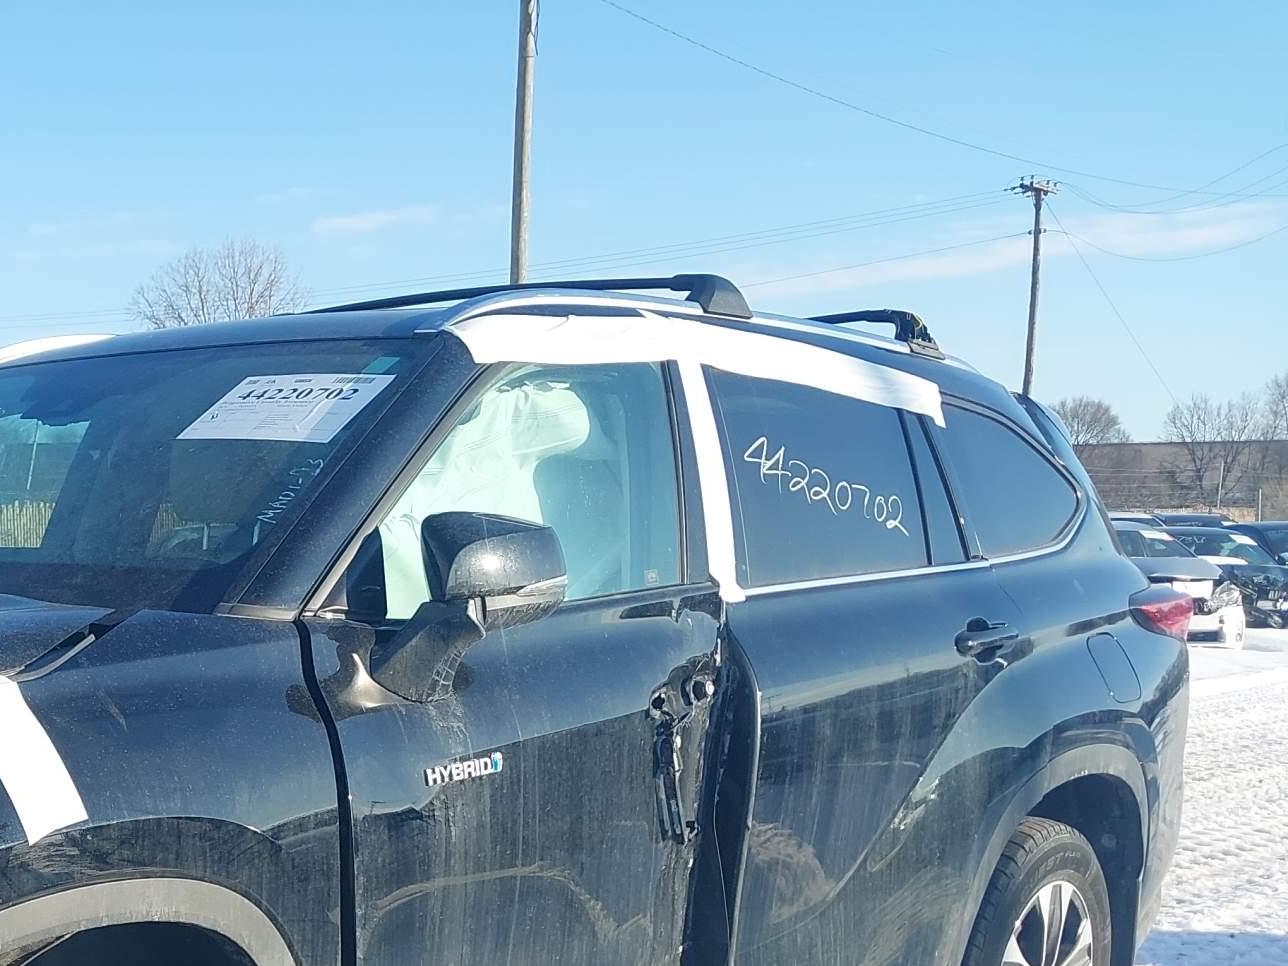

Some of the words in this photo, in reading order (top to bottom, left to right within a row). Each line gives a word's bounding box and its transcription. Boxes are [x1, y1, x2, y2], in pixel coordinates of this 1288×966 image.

[237, 387, 360, 401] 44220702
[743, 435, 910, 537] 44220702
[425, 757, 493, 787] HYBRID
